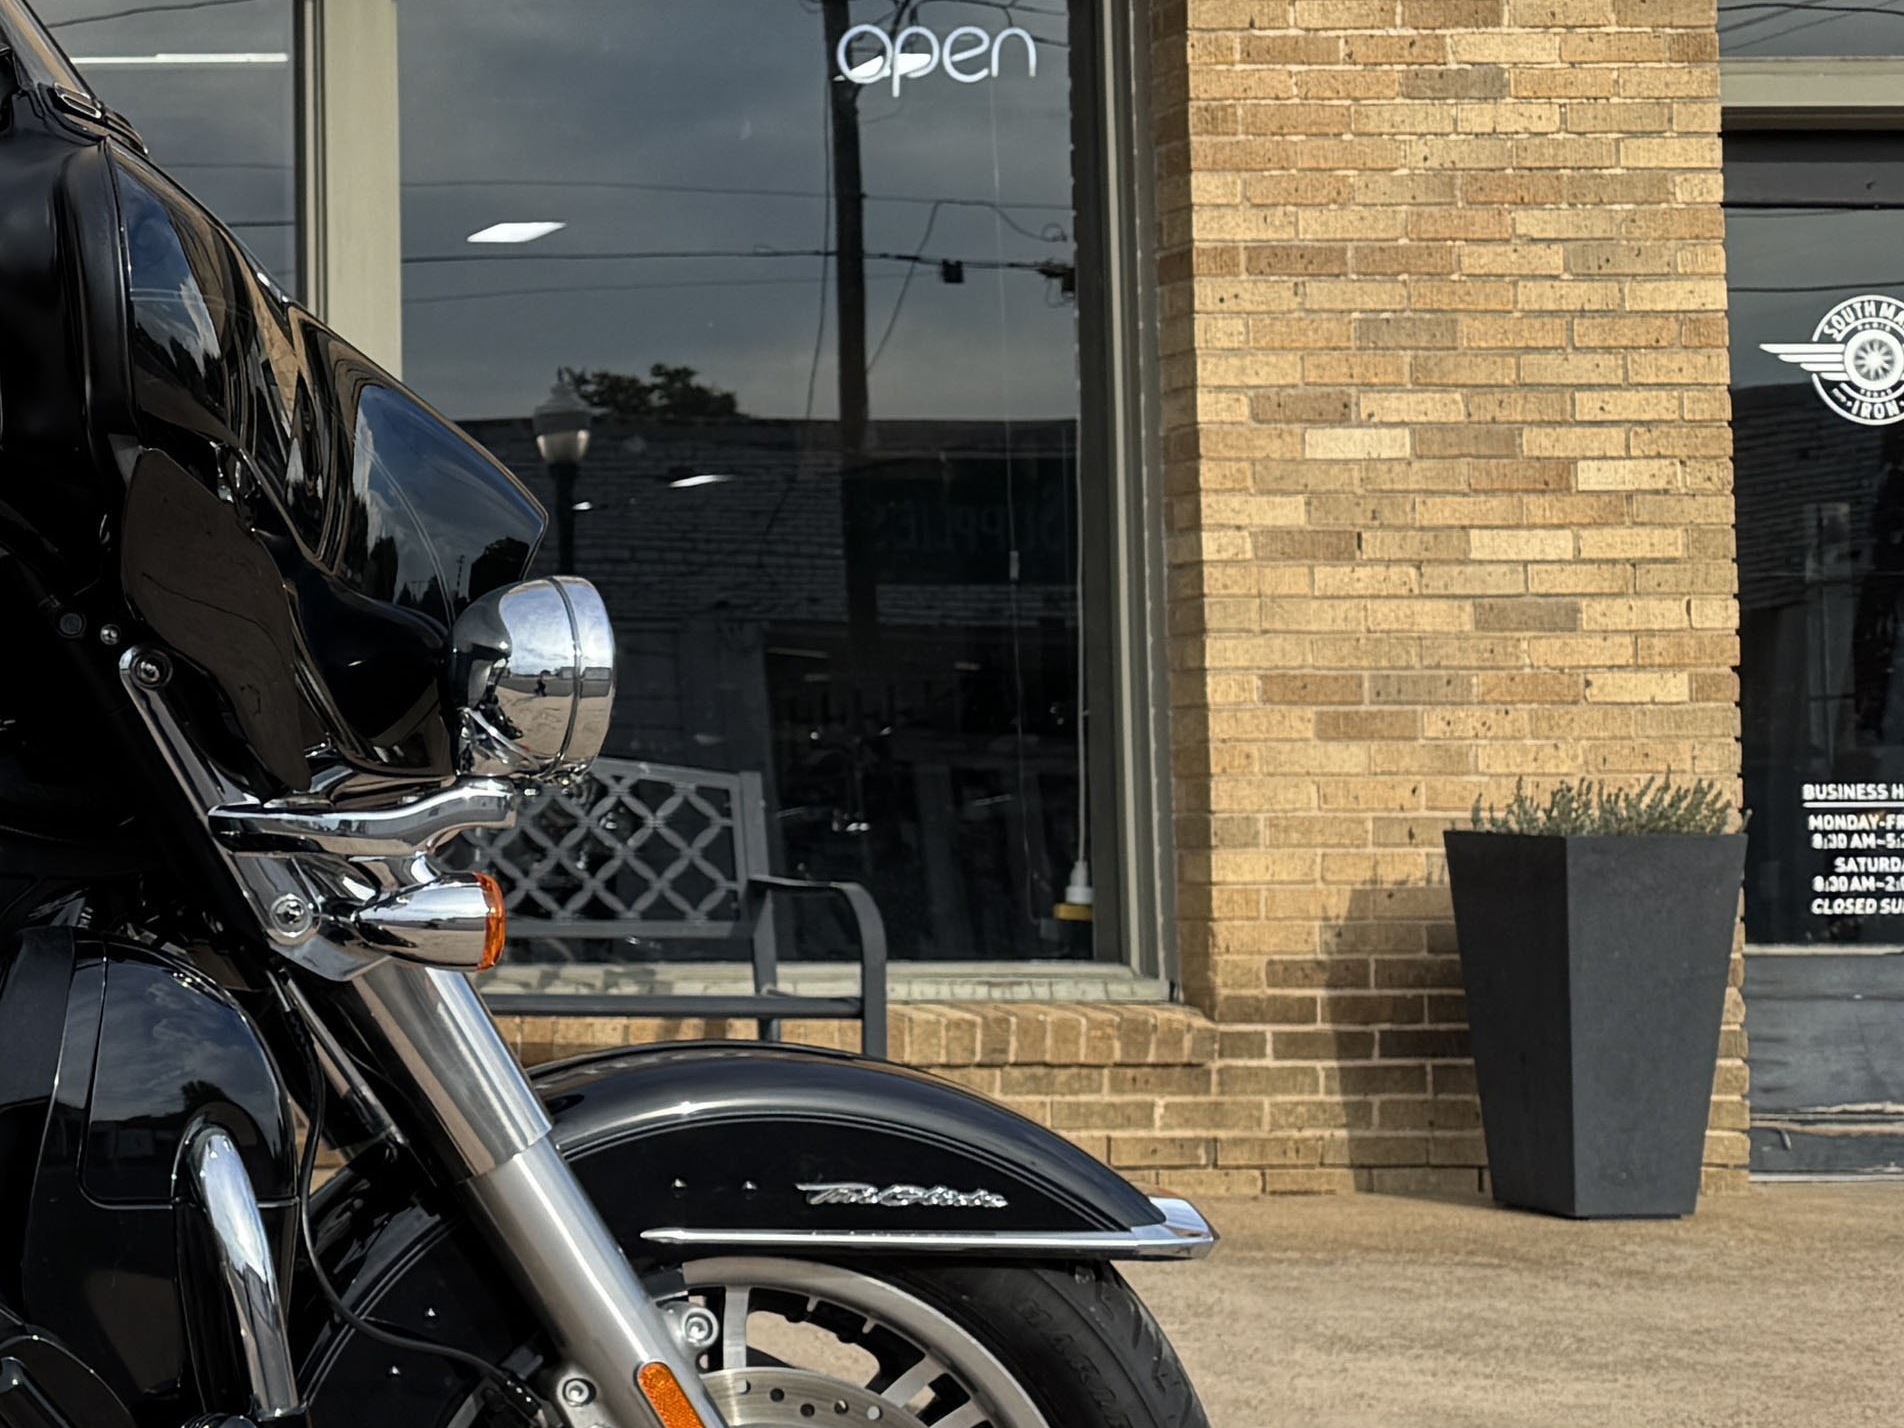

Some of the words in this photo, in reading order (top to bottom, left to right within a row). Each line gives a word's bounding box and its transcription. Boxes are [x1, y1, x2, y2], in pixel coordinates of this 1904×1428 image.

[836, 23, 1037, 98] open
[1823, 300, 1876, 340] SOUTH
[1851, 399, 1900, 419] IRON
[1802, 783, 1889, 801] BUSINESS
[1811, 897, 1878, 915] CLOSED
[1879, 898, 1904, 915] SU
